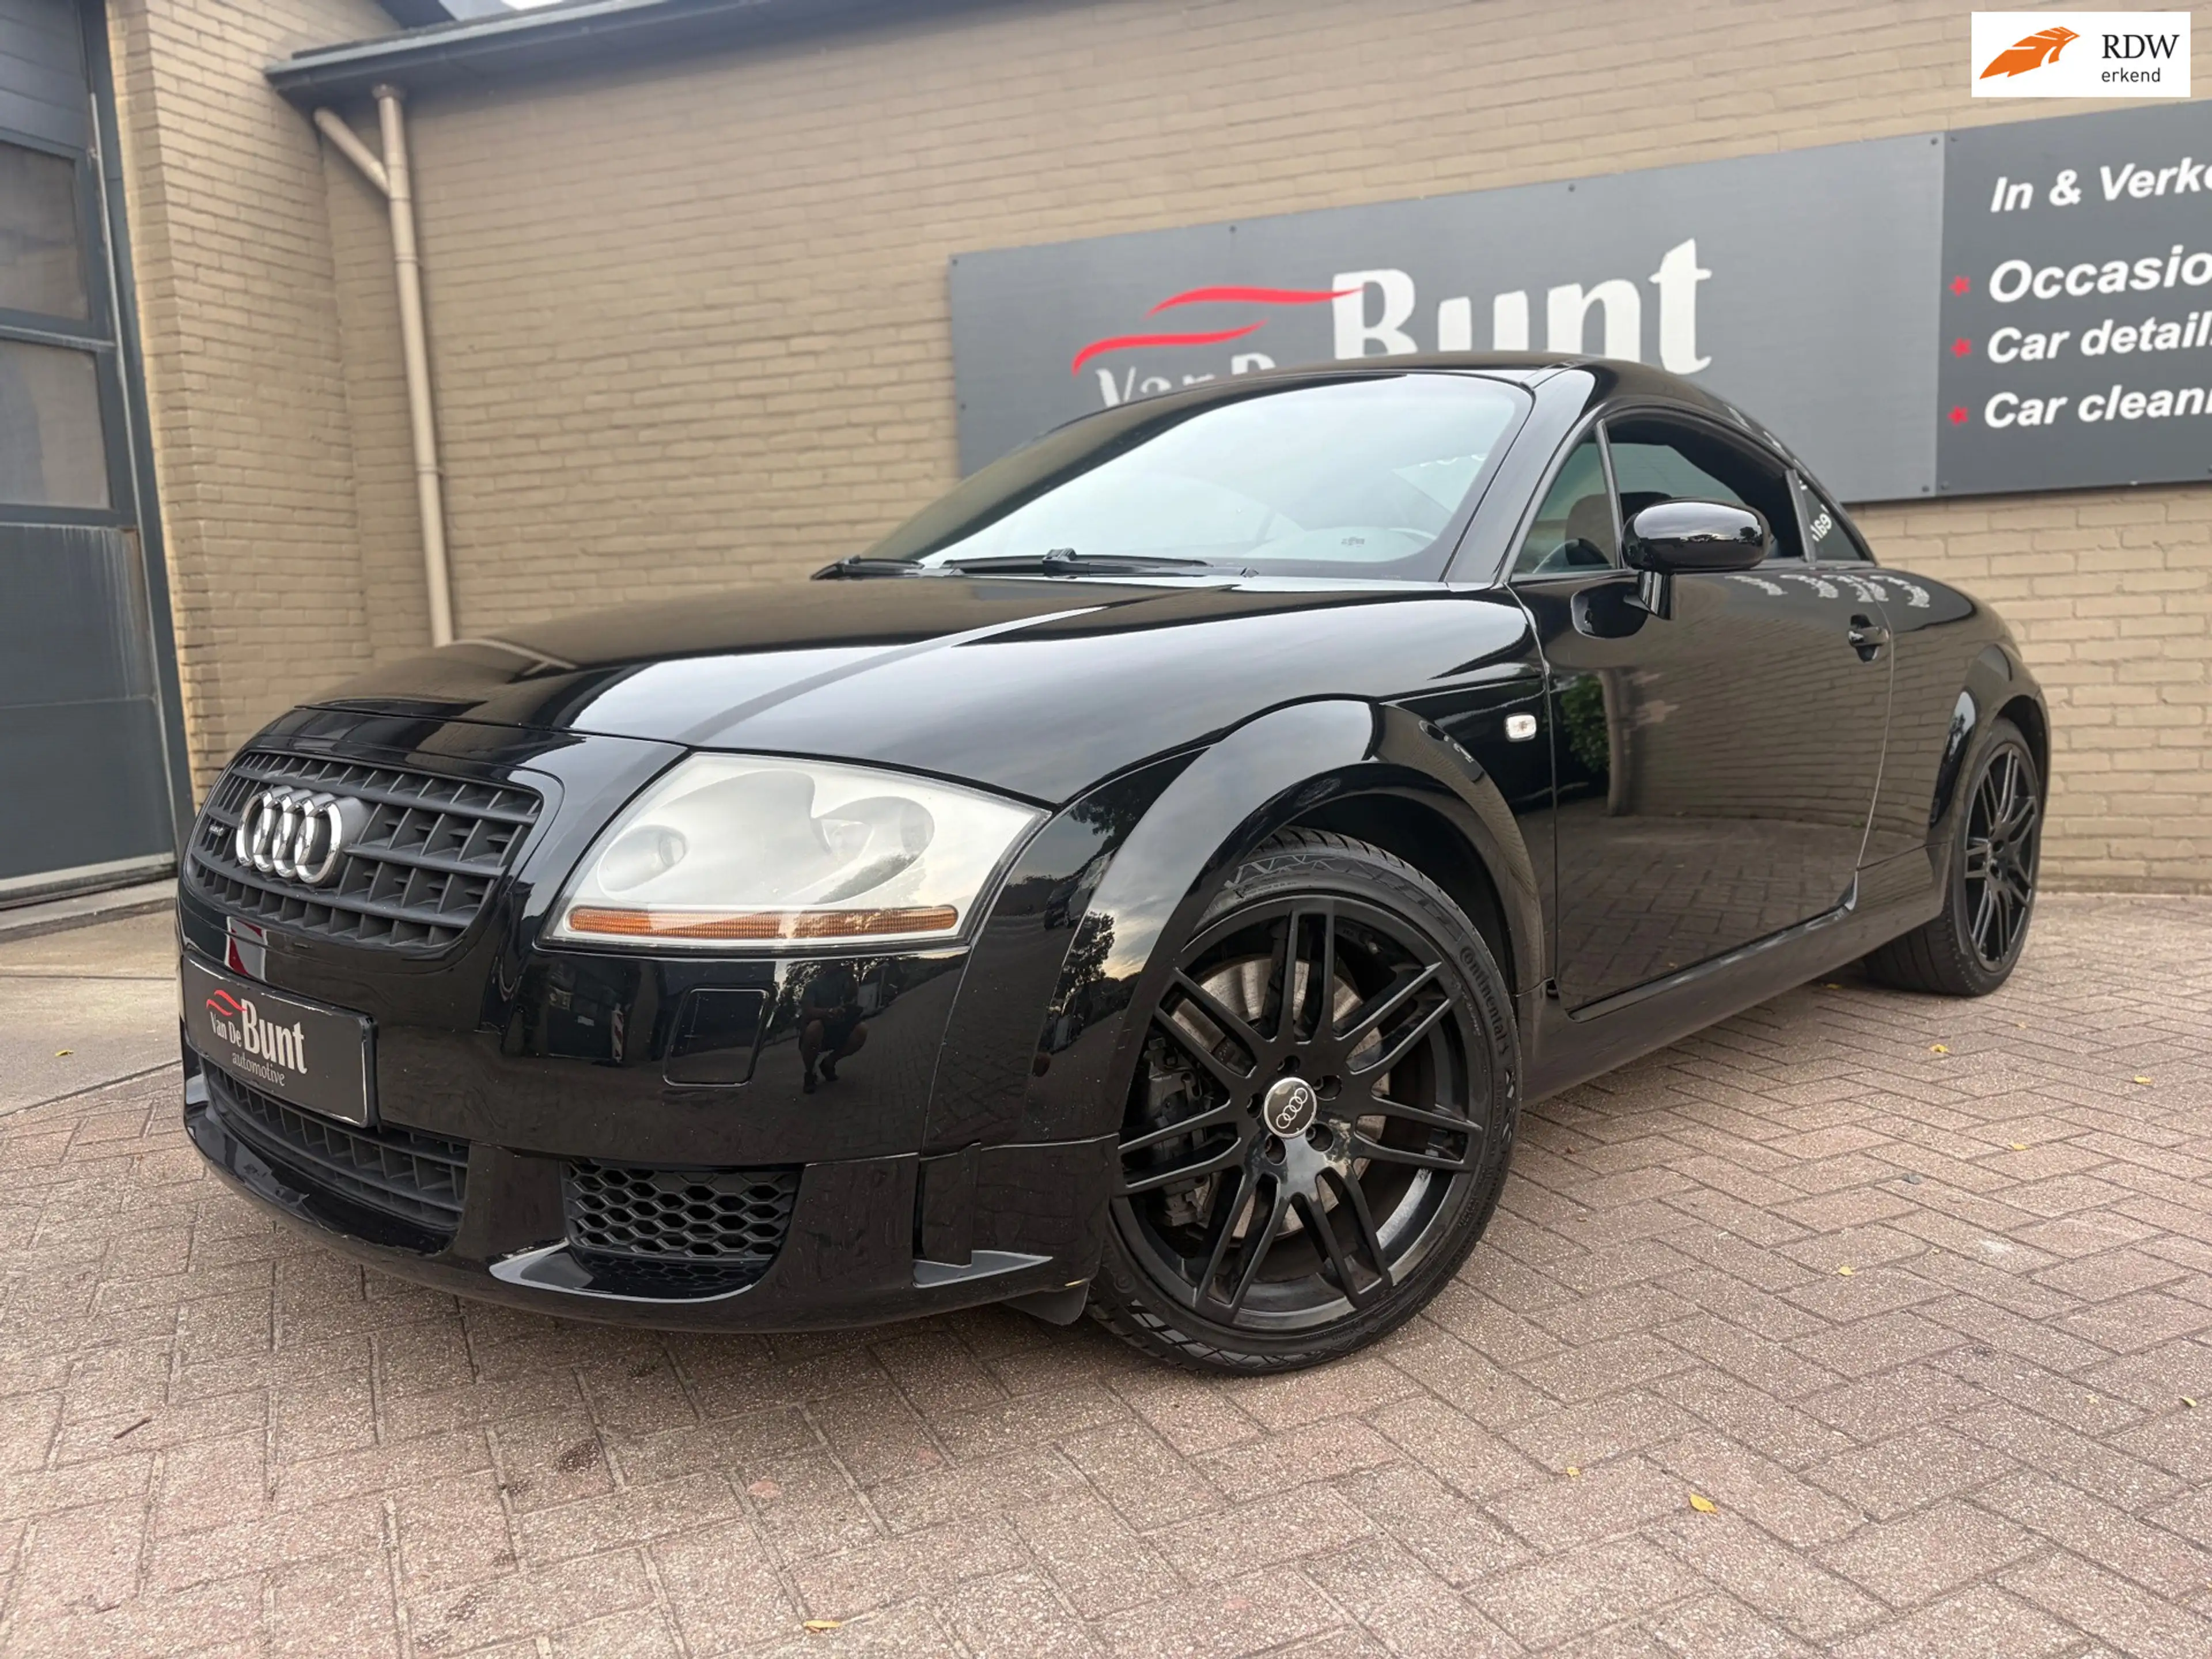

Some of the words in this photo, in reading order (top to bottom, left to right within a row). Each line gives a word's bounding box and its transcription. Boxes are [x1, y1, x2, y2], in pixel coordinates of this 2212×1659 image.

[1990, 176, 2033, 213] In
[2048, 169, 2082, 206] &
[1989, 244, 2212, 302] Occasio
[1332, 238, 1713, 375] Bunt
[1987, 327, 2070, 363] Car
[2080, 310, 2212, 357] detail
[1984, 392, 2068, 428] Car
[1460, 945, 1508, 1041] Continental
[210, 1011, 228, 1040] Van
[228, 1020, 243, 1048] De
[240, 998, 308, 1075] Bunt
[232, 1051, 286, 1087] automotive
